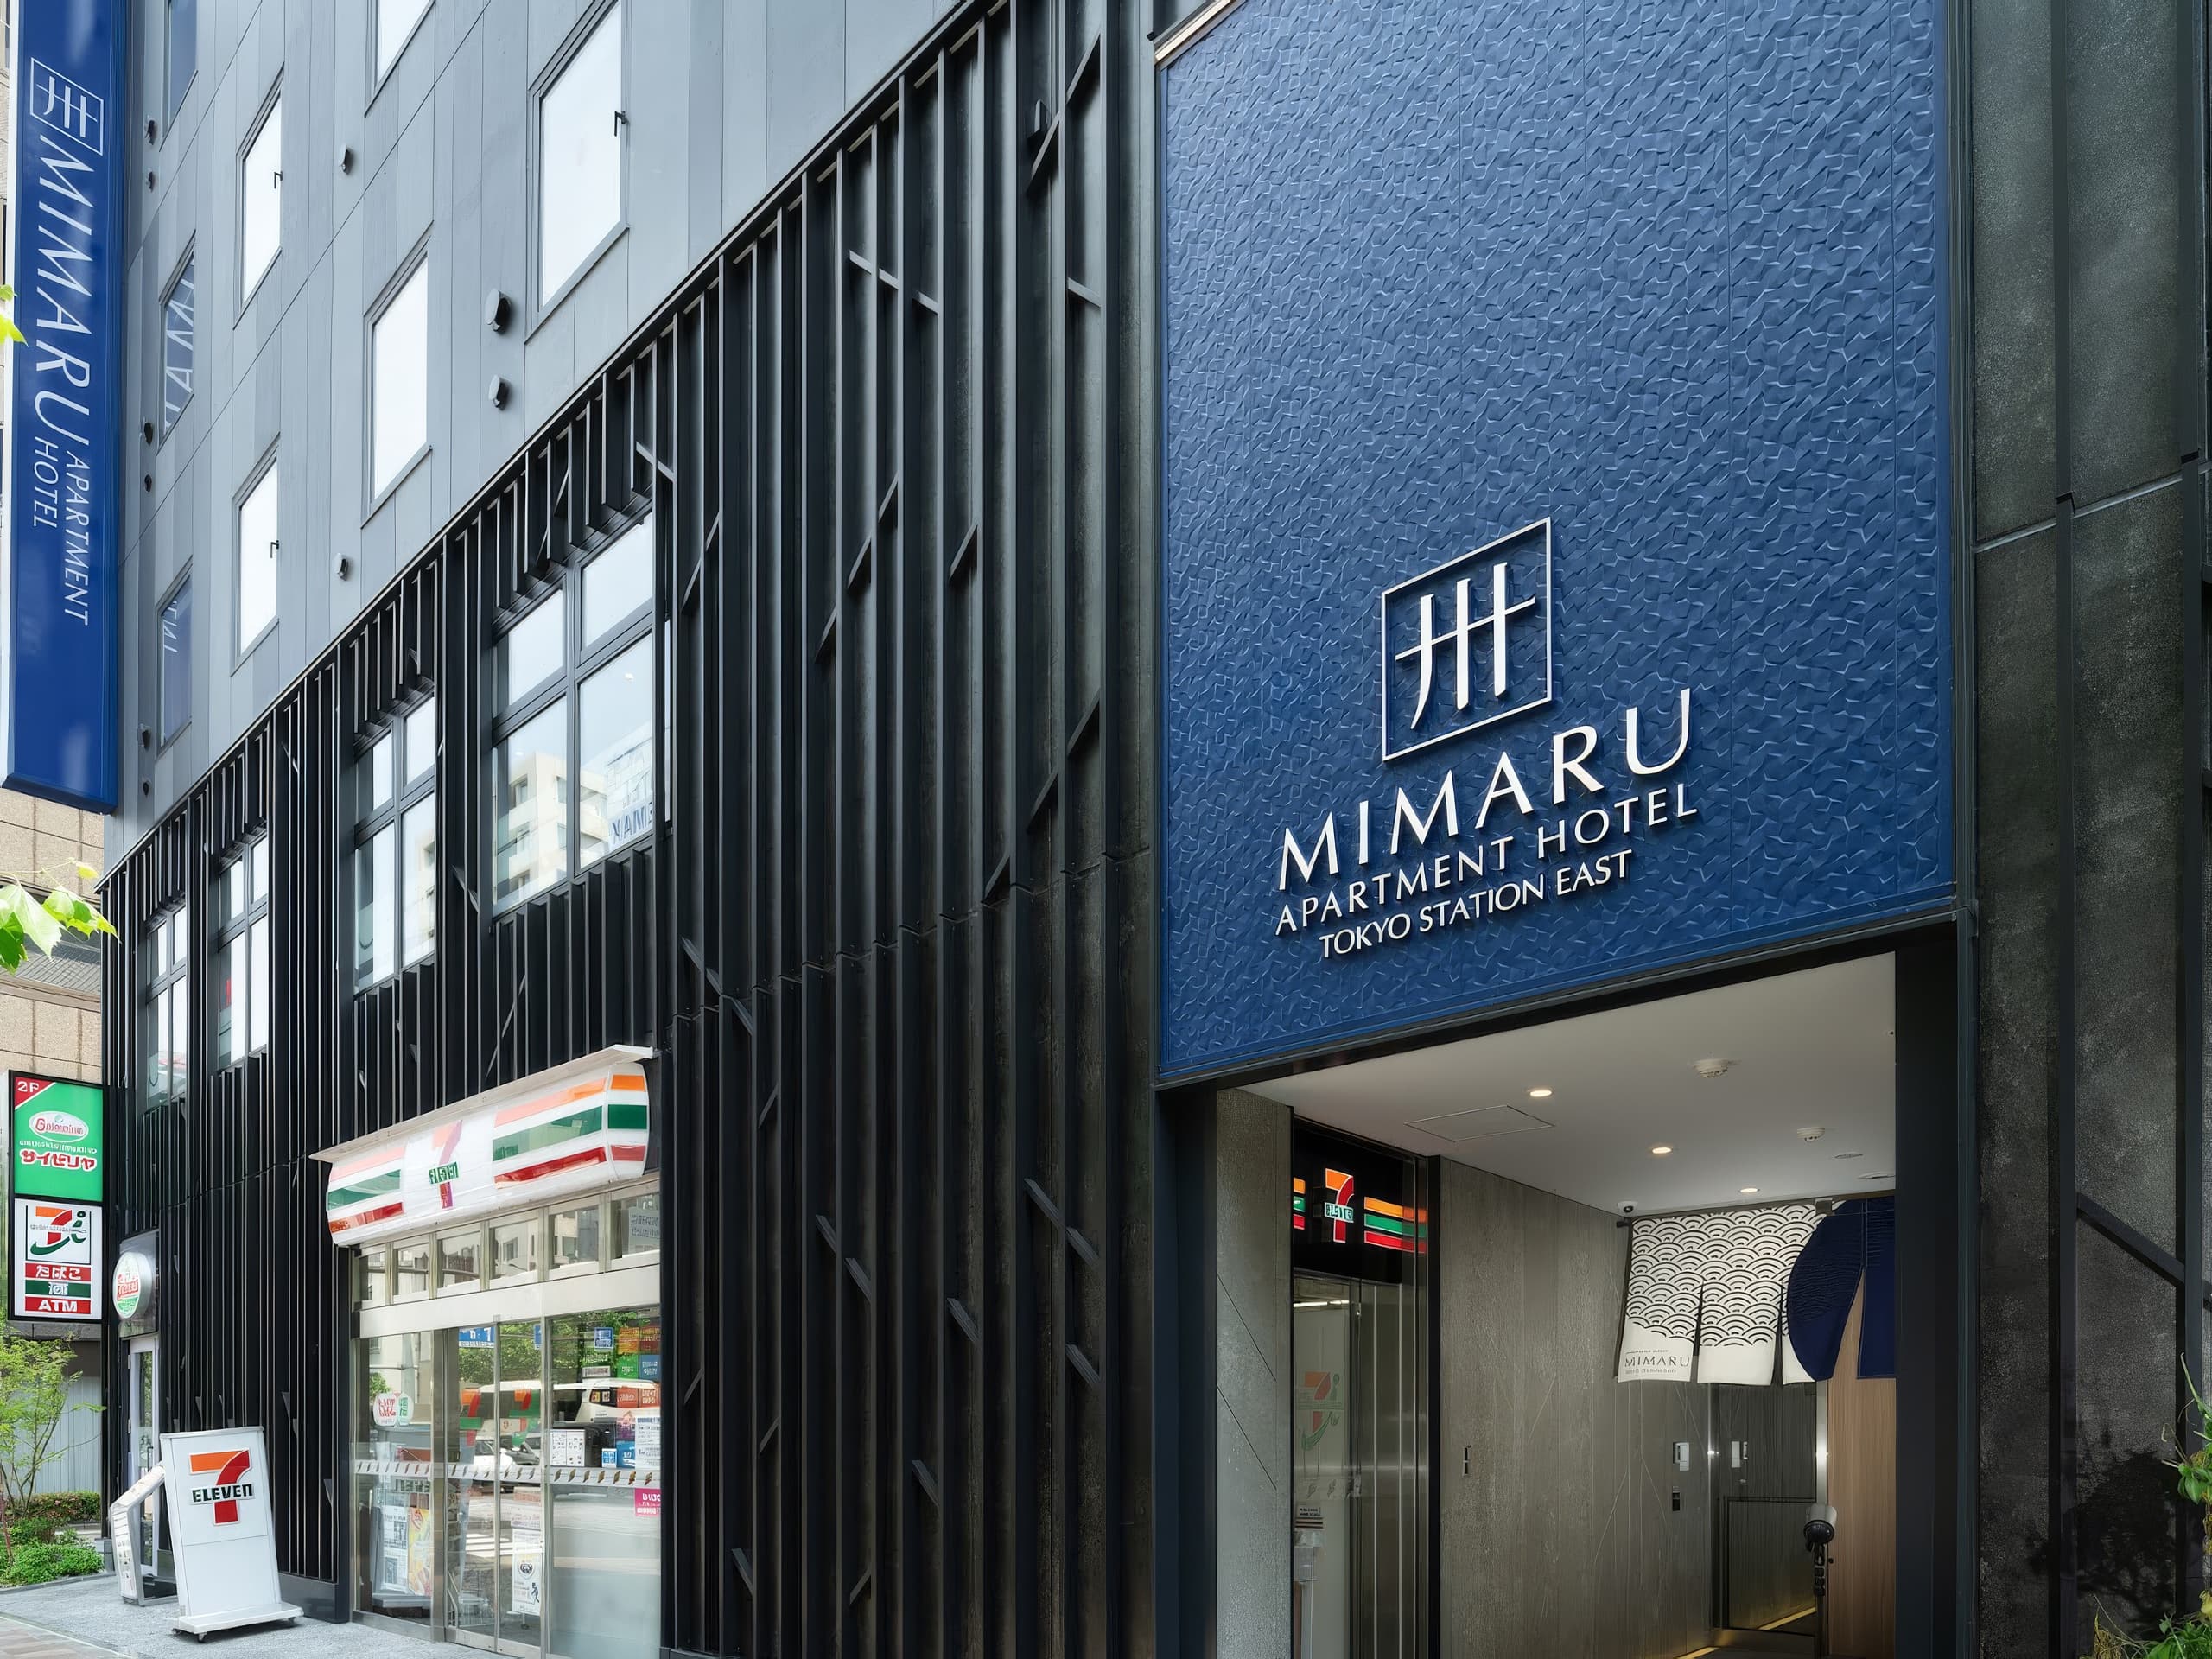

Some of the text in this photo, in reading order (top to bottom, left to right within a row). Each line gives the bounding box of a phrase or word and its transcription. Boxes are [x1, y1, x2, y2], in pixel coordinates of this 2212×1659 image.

[35, 134, 94, 446] MIMARU
[33, 436, 59, 528] HOTEL
[65, 450, 90, 626] APARTMENT
[1279, 689, 1691, 890] MIMARU
[1275, 784, 1698, 935] APARTMENT HOTEL
[1319, 849, 1632, 958] TOKYO STATION EAST
[38, 1300, 78, 1312] ATM
[1625, 1356, 1690, 1367] MIMARU
